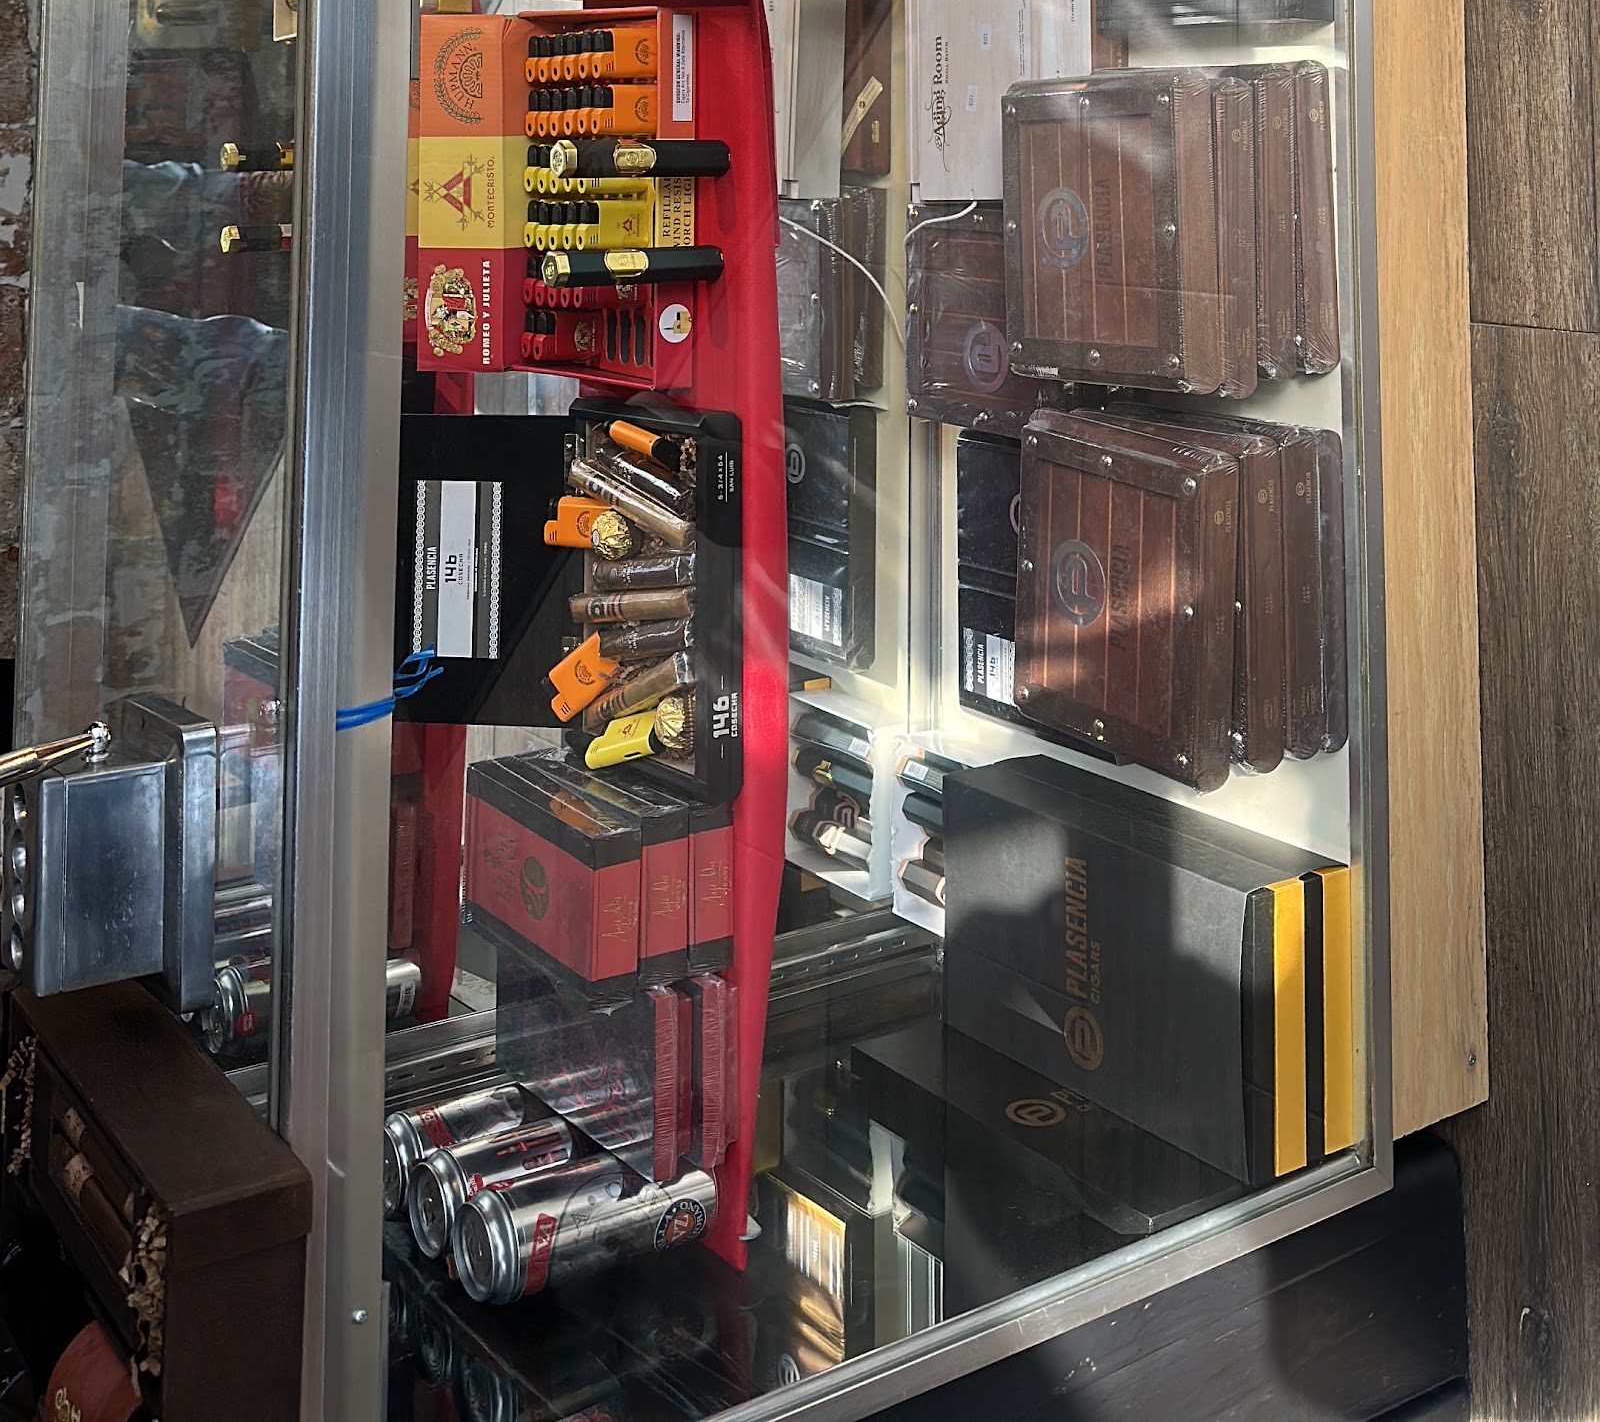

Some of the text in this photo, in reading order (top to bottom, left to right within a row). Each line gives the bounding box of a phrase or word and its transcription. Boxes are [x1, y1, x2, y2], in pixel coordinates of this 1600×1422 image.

[932, 36, 943, 85] Room
[486, 159, 495, 228] MONTECRISTO
[672, 177, 682, 213] RESIS
[683, 210, 692, 245] ORCH
[1094, 178, 1114, 280] PLASENCIA
[482, 260, 491, 307] JULIETA
[482, 323, 491, 365] ROMEO
[425, 546, 437, 590] PLASENCIA
[444, 554, 457, 583] 146
[1108, 544, 1130, 650] PLASENCIA
[712, 695, 730, 738] 146
[730, 692, 738, 738] COSECHA
[1064, 856, 1088, 999] PLASENCIA
[1090, 940, 1100, 1004] CIGARS
